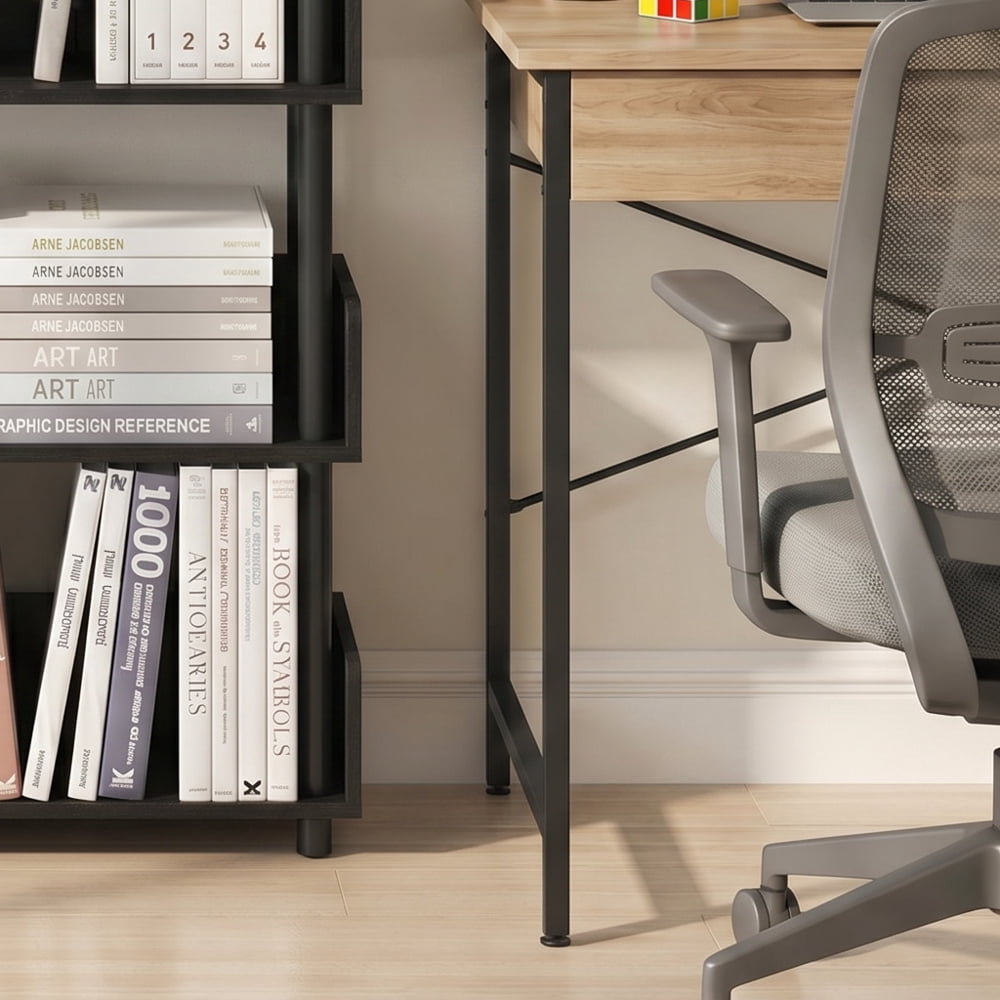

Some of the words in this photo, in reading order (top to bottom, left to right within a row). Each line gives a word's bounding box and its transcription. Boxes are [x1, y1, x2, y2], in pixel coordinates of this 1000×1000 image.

[147, 33, 156, 50] 1
[183, 33, 195, 50] 2
[218, 33, 230, 50] 3
[254, 33, 267, 50] 4
[32, 238, 63, 251] ARNE
[66, 238, 125, 251] JACOBSEN
[32, 265, 63, 278] ARNE
[66, 265, 125, 278] JACOBSEN
[32, 293, 63, 306] ARNE
[66, 293, 125, 306] JACOBSEN
[32, 320, 63, 332] ARNE
[66, 320, 125, 332] JACOBSEN
[33, 347, 80, 367] ART
[87, 347, 119, 367] ART
[32, 379, 79, 400] ART
[86, 379, 115, 400] ART
[55, 418, 110, 433] DESIGN
[114, 418, 211, 433] REFERENCE
[131, 484, 171, 579] 1000
